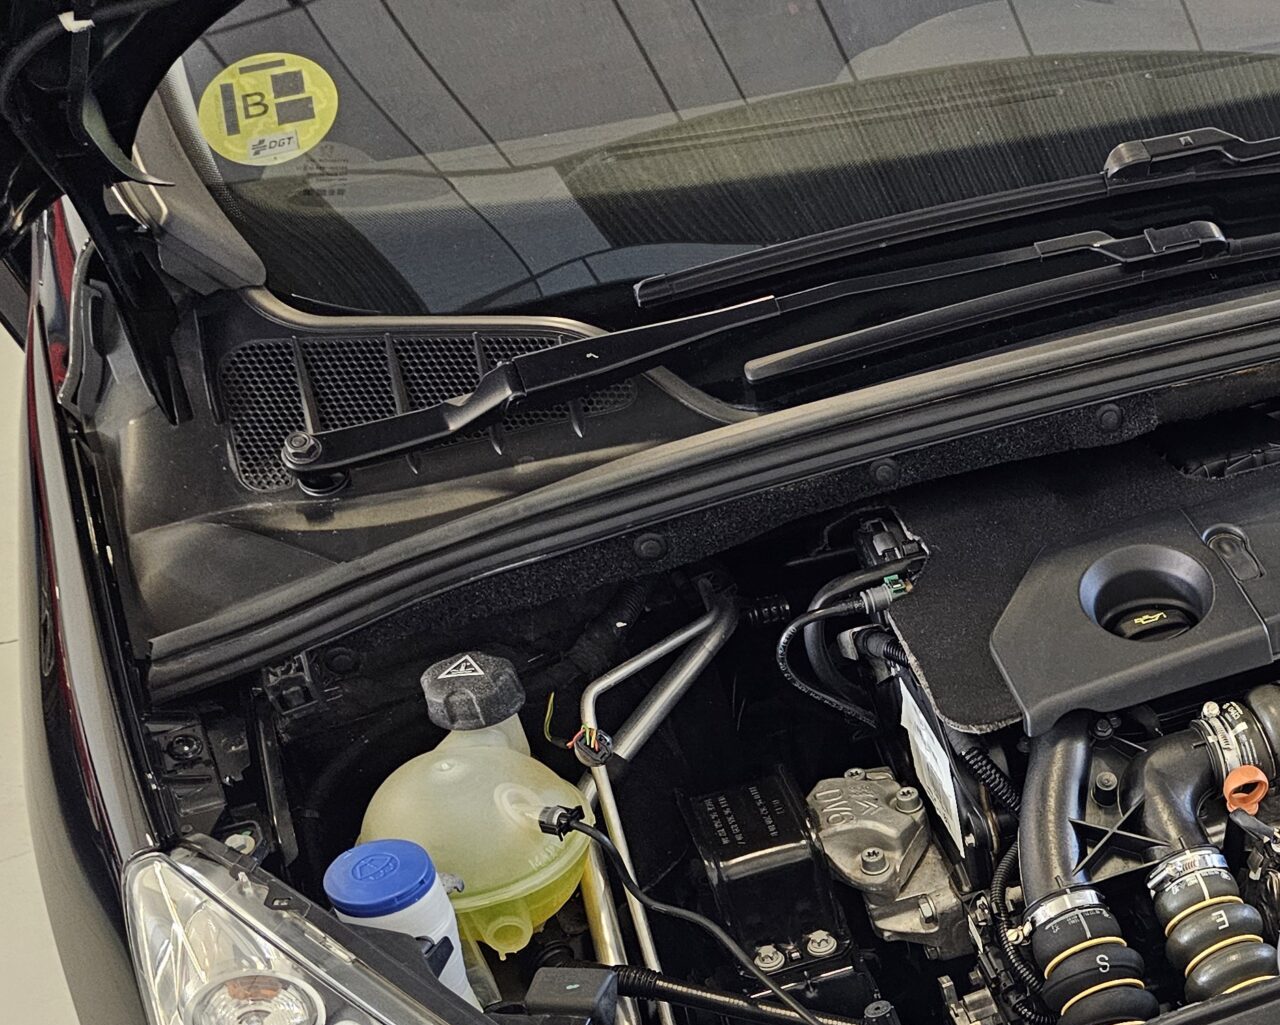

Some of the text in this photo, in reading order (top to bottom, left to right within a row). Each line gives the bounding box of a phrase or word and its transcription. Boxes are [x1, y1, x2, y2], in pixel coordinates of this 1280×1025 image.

[241, 92, 269, 120] B
[268, 136, 294, 150] DGT
[814, 788, 857, 827] DV6
[1211, 910, 1230, 930] E
[1096, 954, 1110, 973] S
